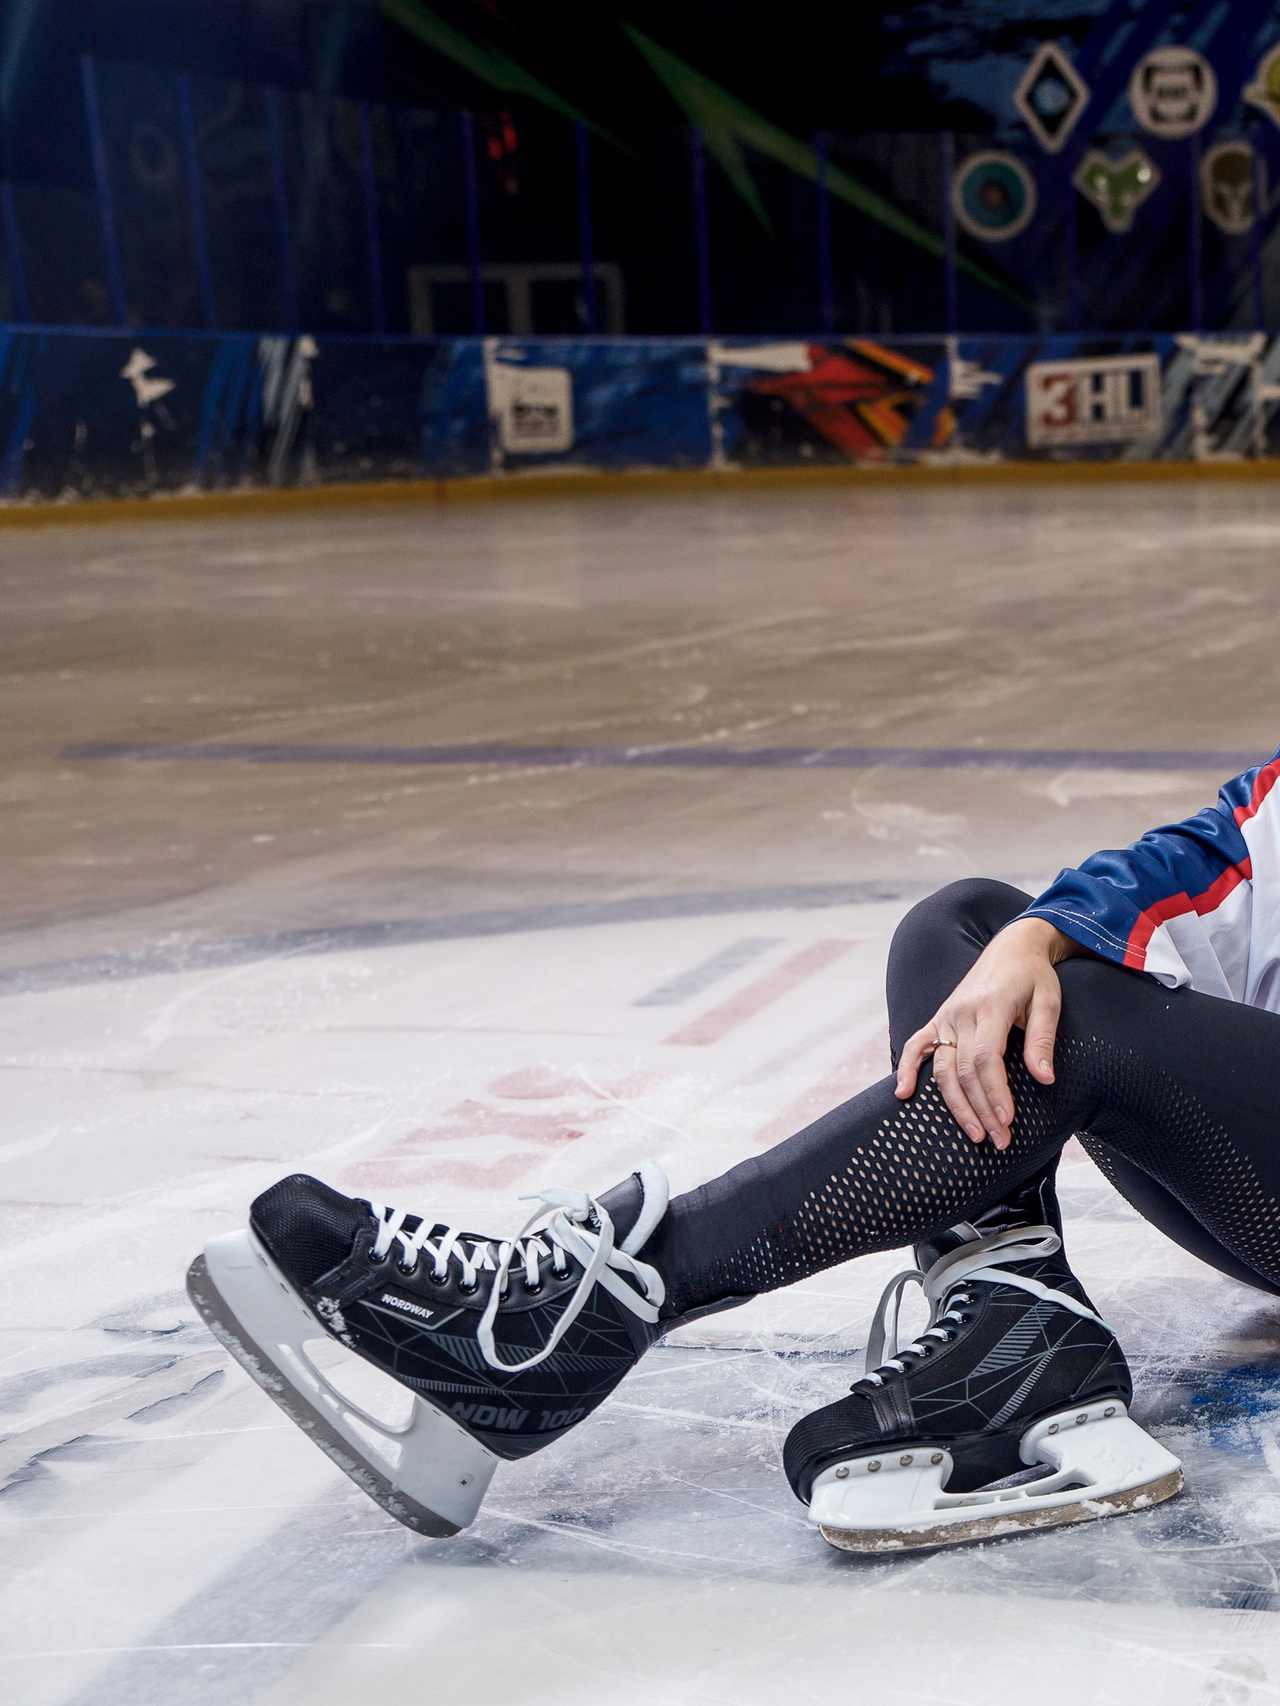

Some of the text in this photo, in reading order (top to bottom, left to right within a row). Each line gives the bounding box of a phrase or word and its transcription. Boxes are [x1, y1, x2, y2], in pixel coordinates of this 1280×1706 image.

[381, 1293, 434, 1319] NORDWAY
[450, 1401, 585, 1430] NDW 100
